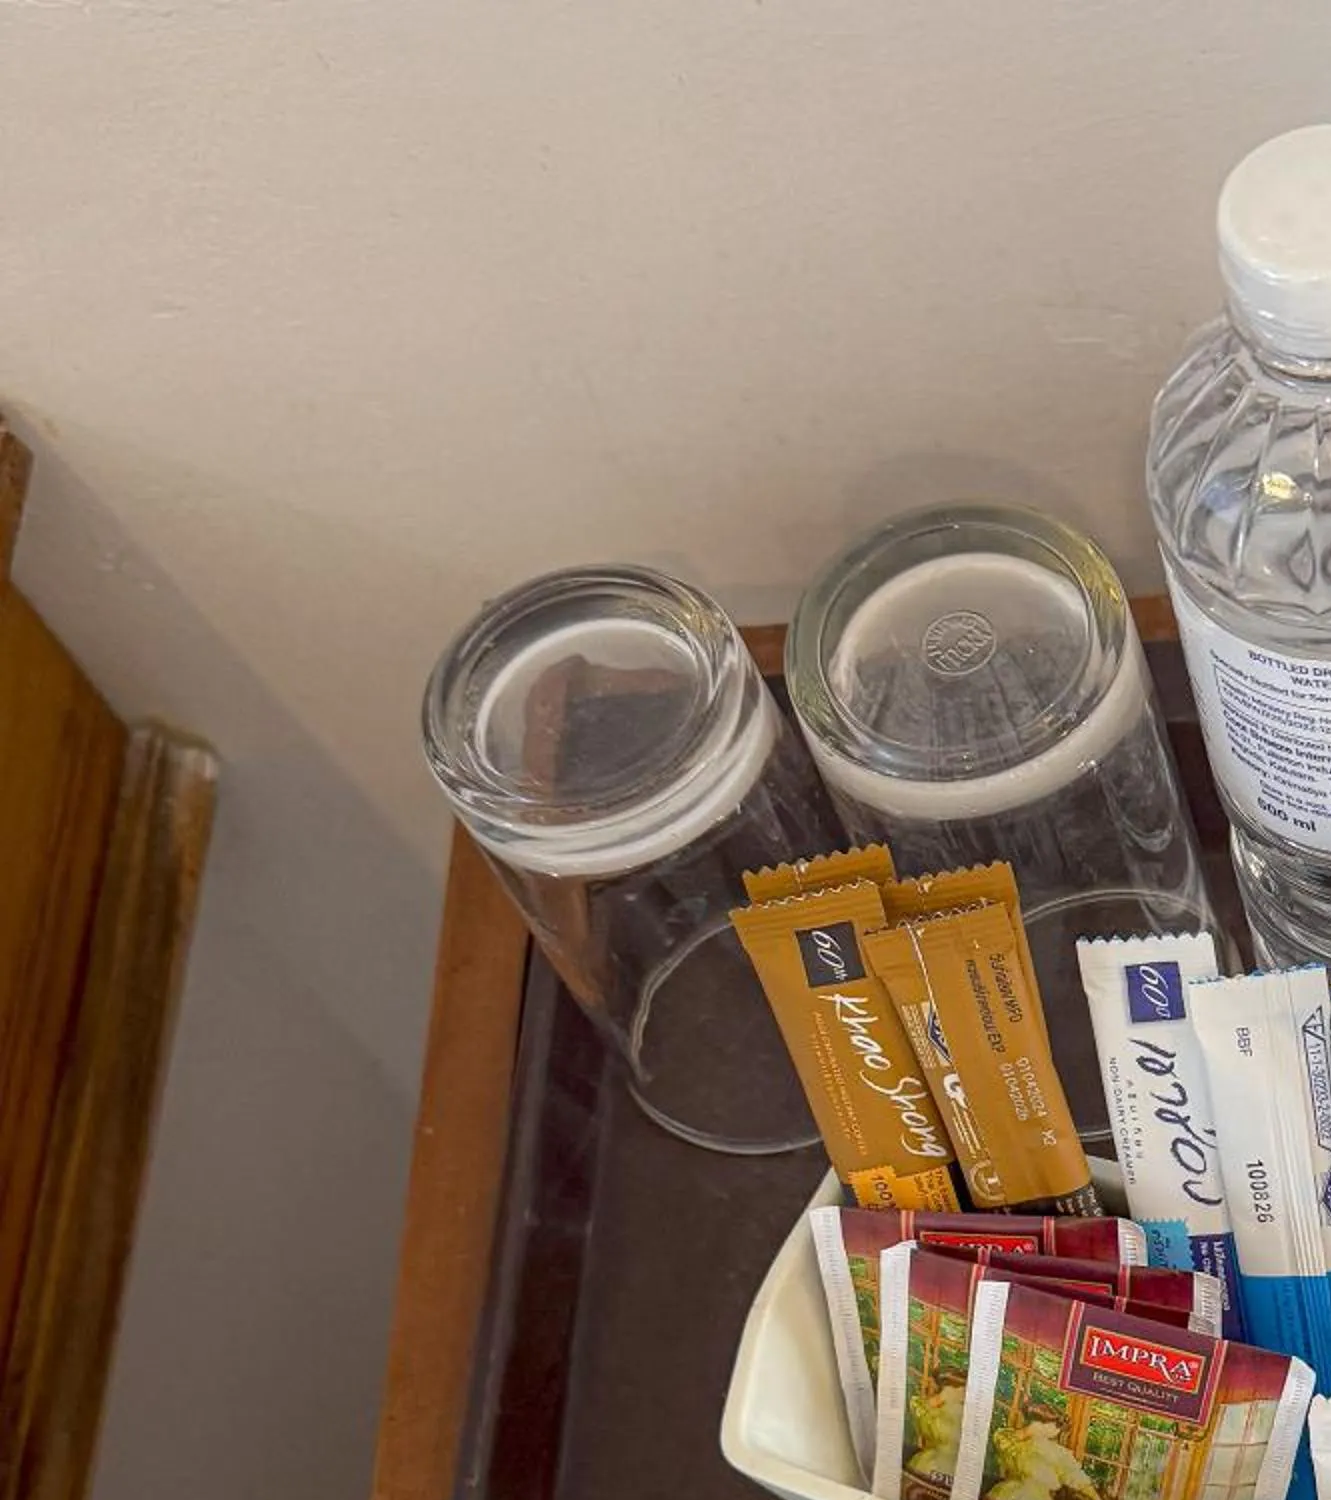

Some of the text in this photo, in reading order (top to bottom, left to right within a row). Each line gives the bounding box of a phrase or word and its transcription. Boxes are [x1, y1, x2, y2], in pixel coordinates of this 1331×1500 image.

[1247, 648, 1308, 675] BOTTLED
[1255, 793, 1316, 833] 500 ml
[817, 992, 892, 1072] Khao
[859, 1071, 947, 1158] Shong
[1234, 1025, 1274, 1224] BBF 100826
[1090, 1335, 1191, 1383] IMPRA
[1127, 1381, 1179, 1403] QUALITY
